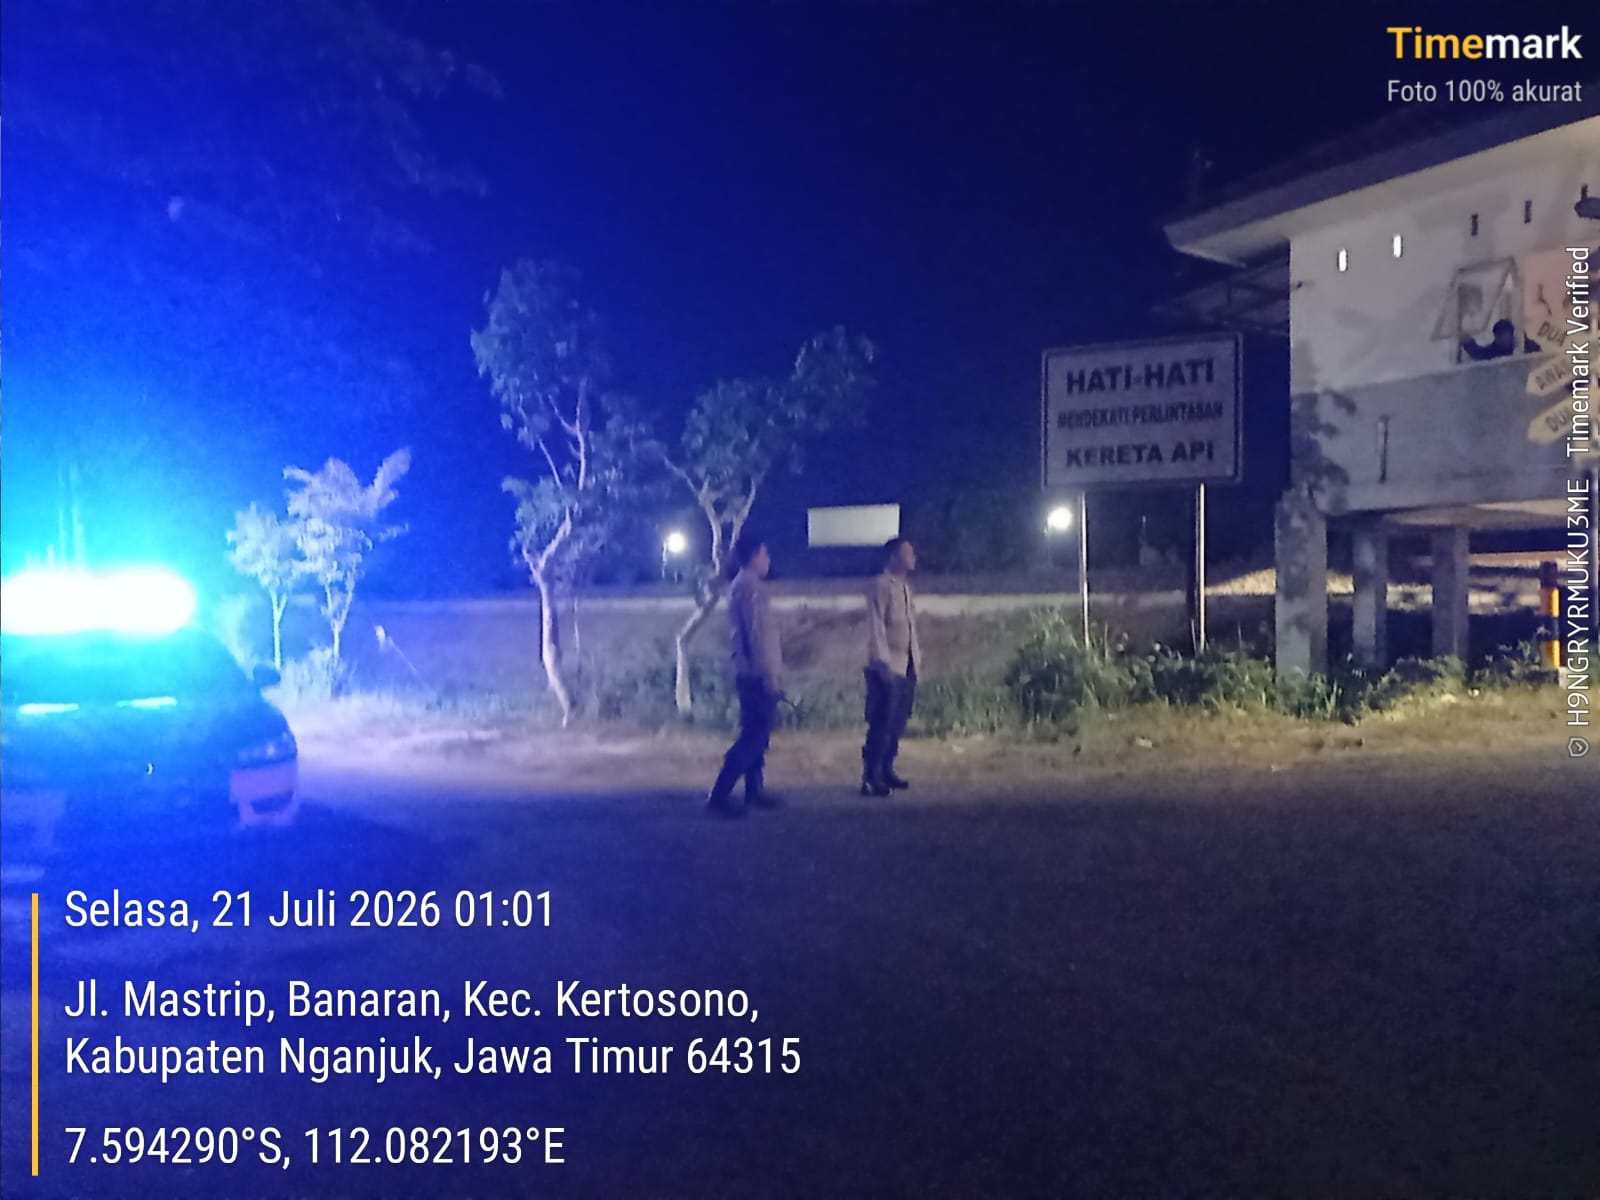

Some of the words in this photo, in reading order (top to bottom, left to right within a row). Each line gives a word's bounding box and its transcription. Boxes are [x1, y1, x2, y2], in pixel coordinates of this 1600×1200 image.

[1066, 358, 1215, 396] HATI-HATI
[1057, 408, 1129, 430] MENDEKATI
[1066, 443, 1164, 468] KERETA
[1171, 439, 1214, 463] API
